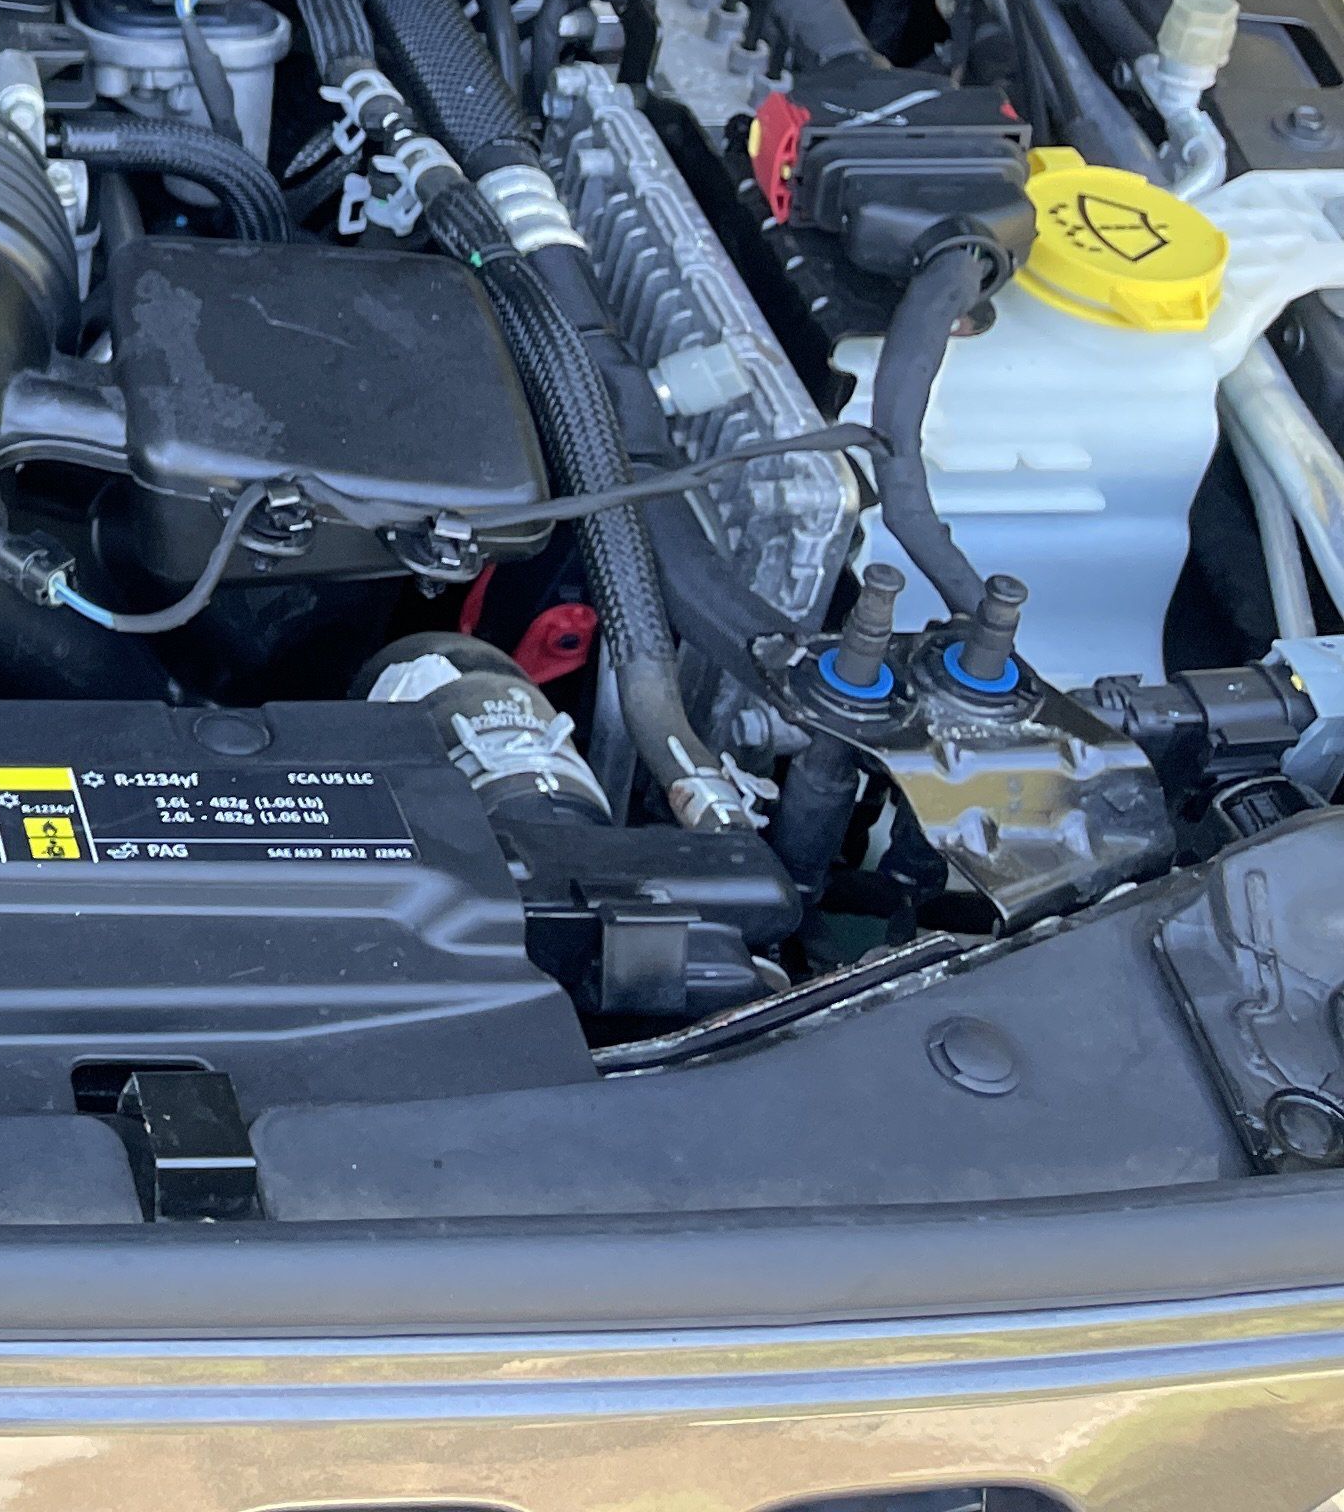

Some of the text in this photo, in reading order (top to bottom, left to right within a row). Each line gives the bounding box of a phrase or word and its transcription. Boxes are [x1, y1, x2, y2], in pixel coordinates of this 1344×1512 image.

[114, 772, 199, 788] R-1234yf
[287, 772, 375, 785] FCA US LLC
[155, 796, 190, 809] 3.6L
[209, 796, 250, 810] 482g
[254, 796, 295, 810] (1.06
[160, 811, 195, 823] 2.0L
[214, 811, 255, 825] 482g
[259, 810, 301, 824] (1.06
[147, 843, 189, 858] PAG
[267, 847, 293, 859] SAE
